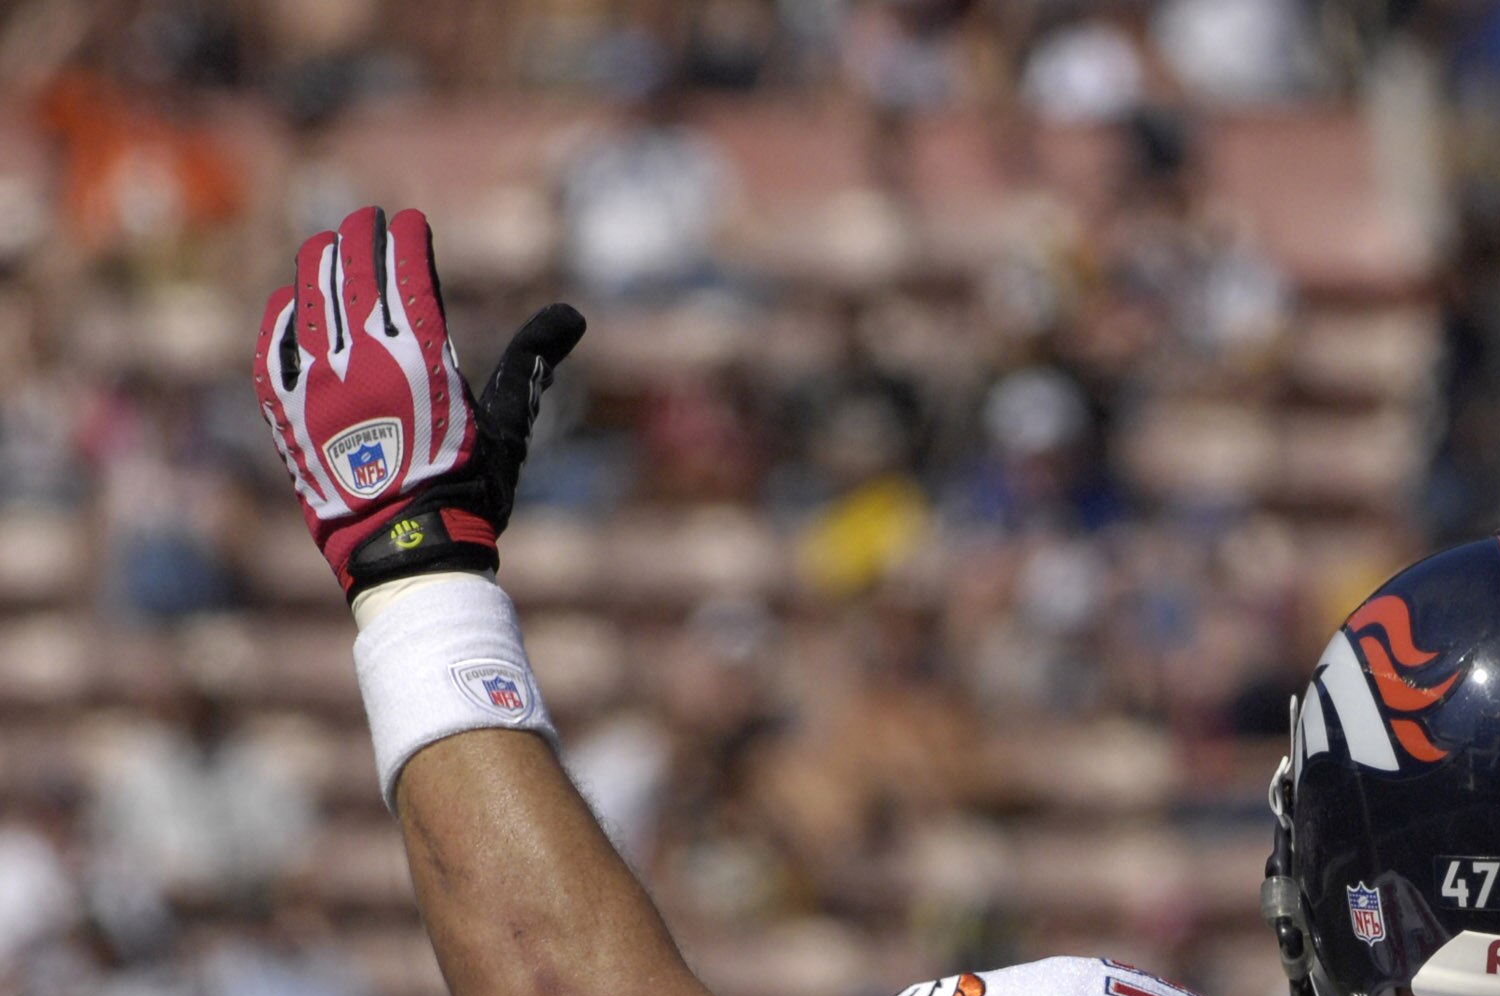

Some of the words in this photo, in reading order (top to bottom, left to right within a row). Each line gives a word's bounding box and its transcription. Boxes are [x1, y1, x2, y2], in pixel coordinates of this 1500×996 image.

[333, 427, 393, 459] EQUIPMENT
[354, 463, 385, 486] NFL
[465, 669, 522, 682] EQUIPMENT
[1441, 860, 1500, 909] 47
[1353, 909, 1382, 938] NFL
